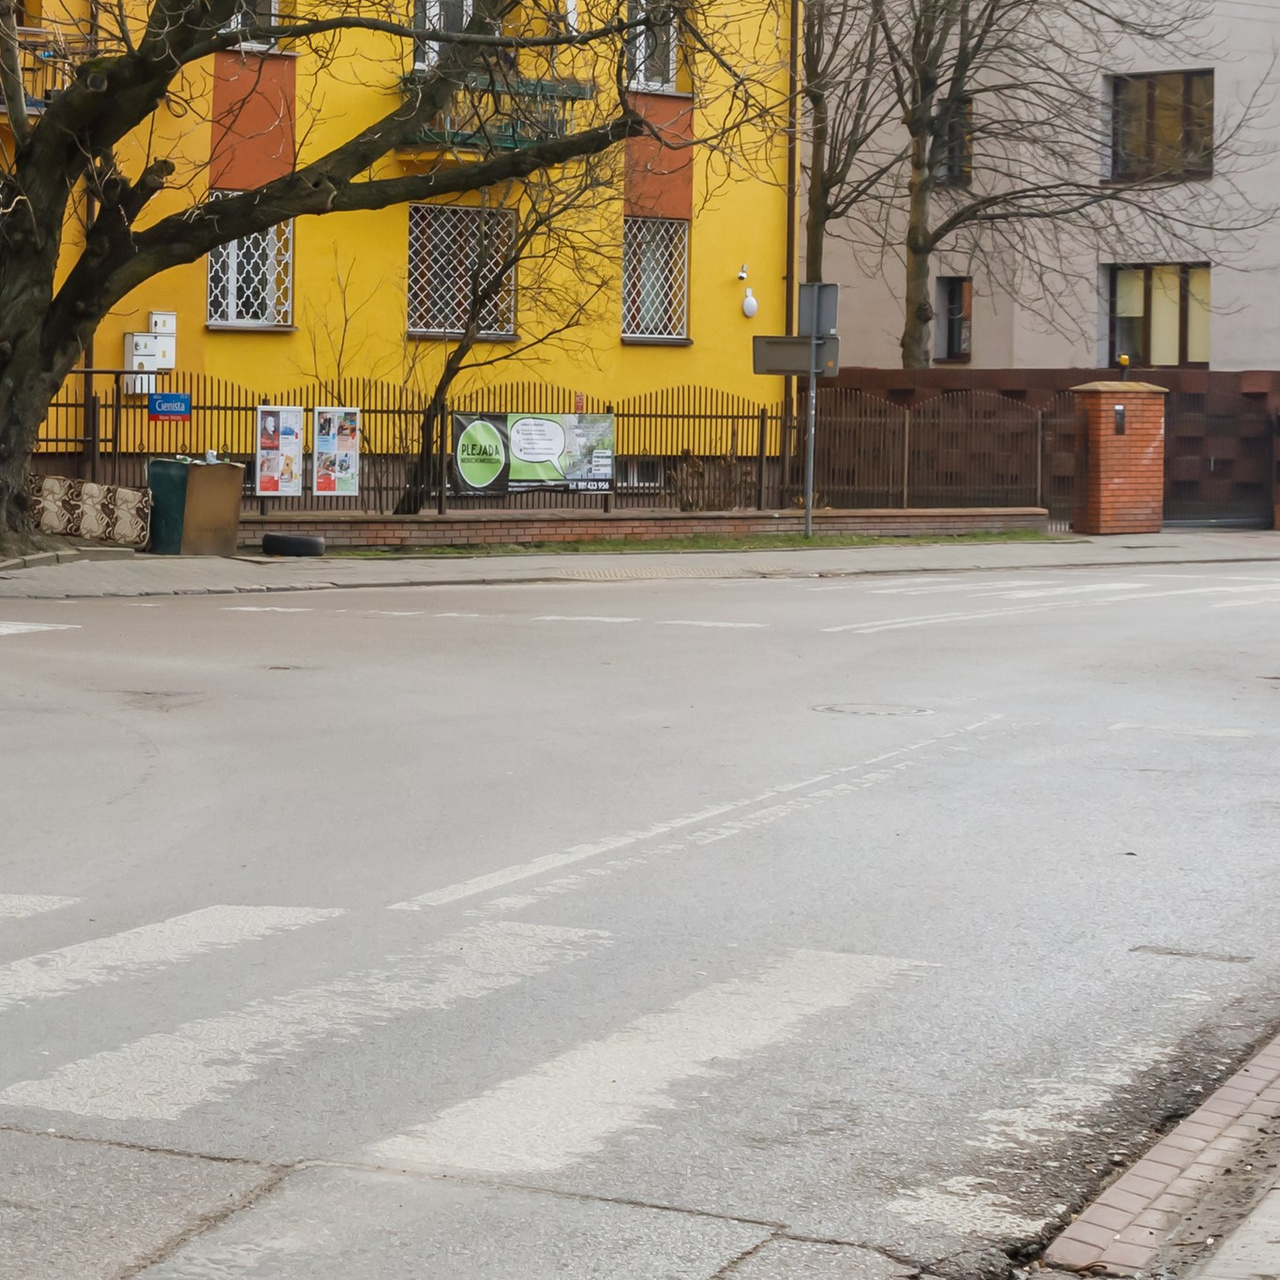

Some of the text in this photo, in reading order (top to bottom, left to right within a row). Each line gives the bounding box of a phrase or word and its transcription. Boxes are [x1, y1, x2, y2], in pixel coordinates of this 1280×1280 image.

[156, 400, 185, 411] Cienista
[461, 443, 501, 457] PLEJADA
[598, 482, 610, 490] 956
